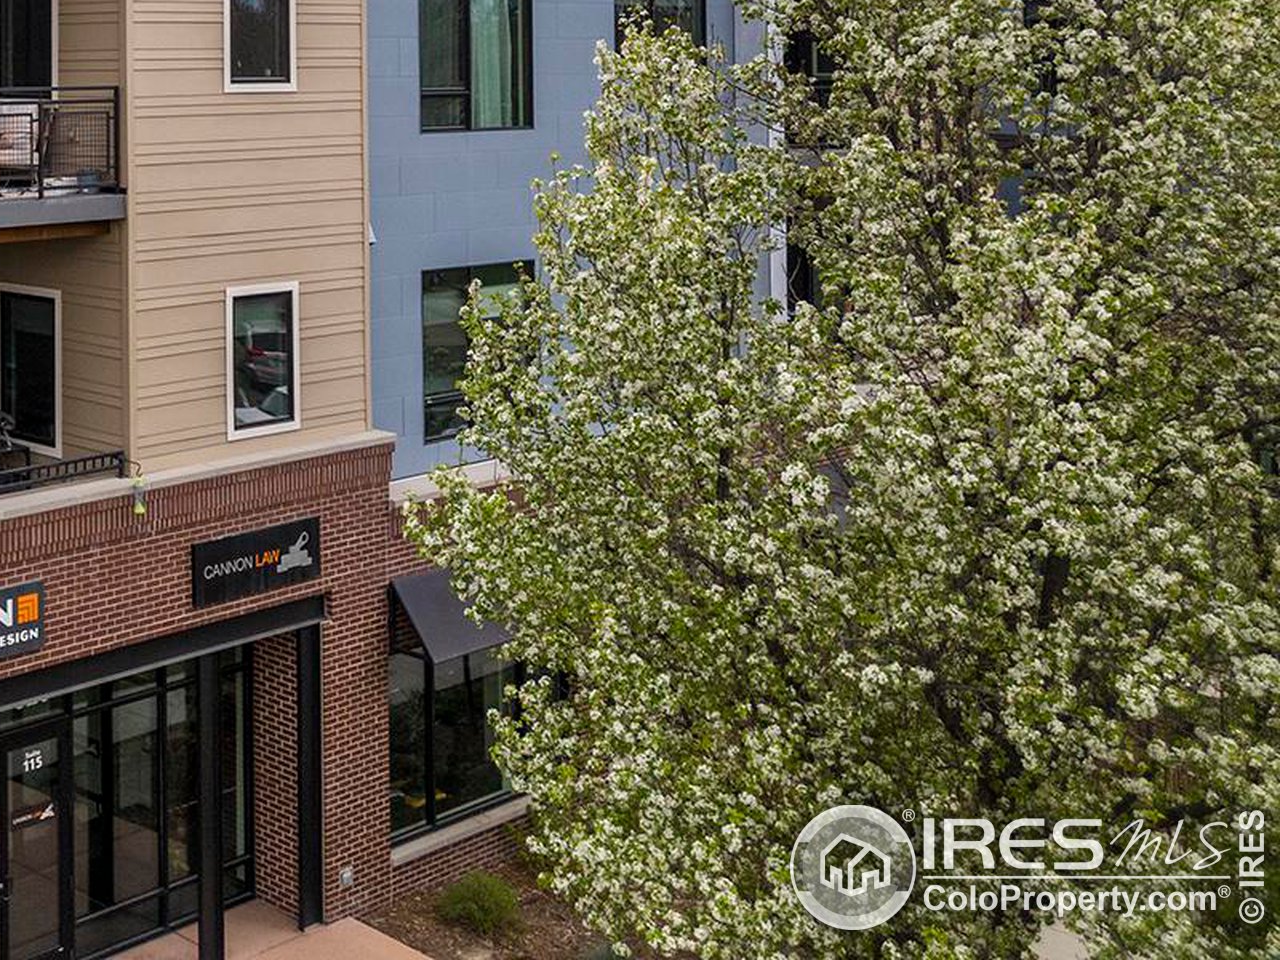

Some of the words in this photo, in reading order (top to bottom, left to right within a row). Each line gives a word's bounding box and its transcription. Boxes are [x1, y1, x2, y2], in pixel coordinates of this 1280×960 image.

[204, 555, 254, 580] CANNON
[255, 548, 280, 568] LAW
[22, 755, 43, 772] 115
